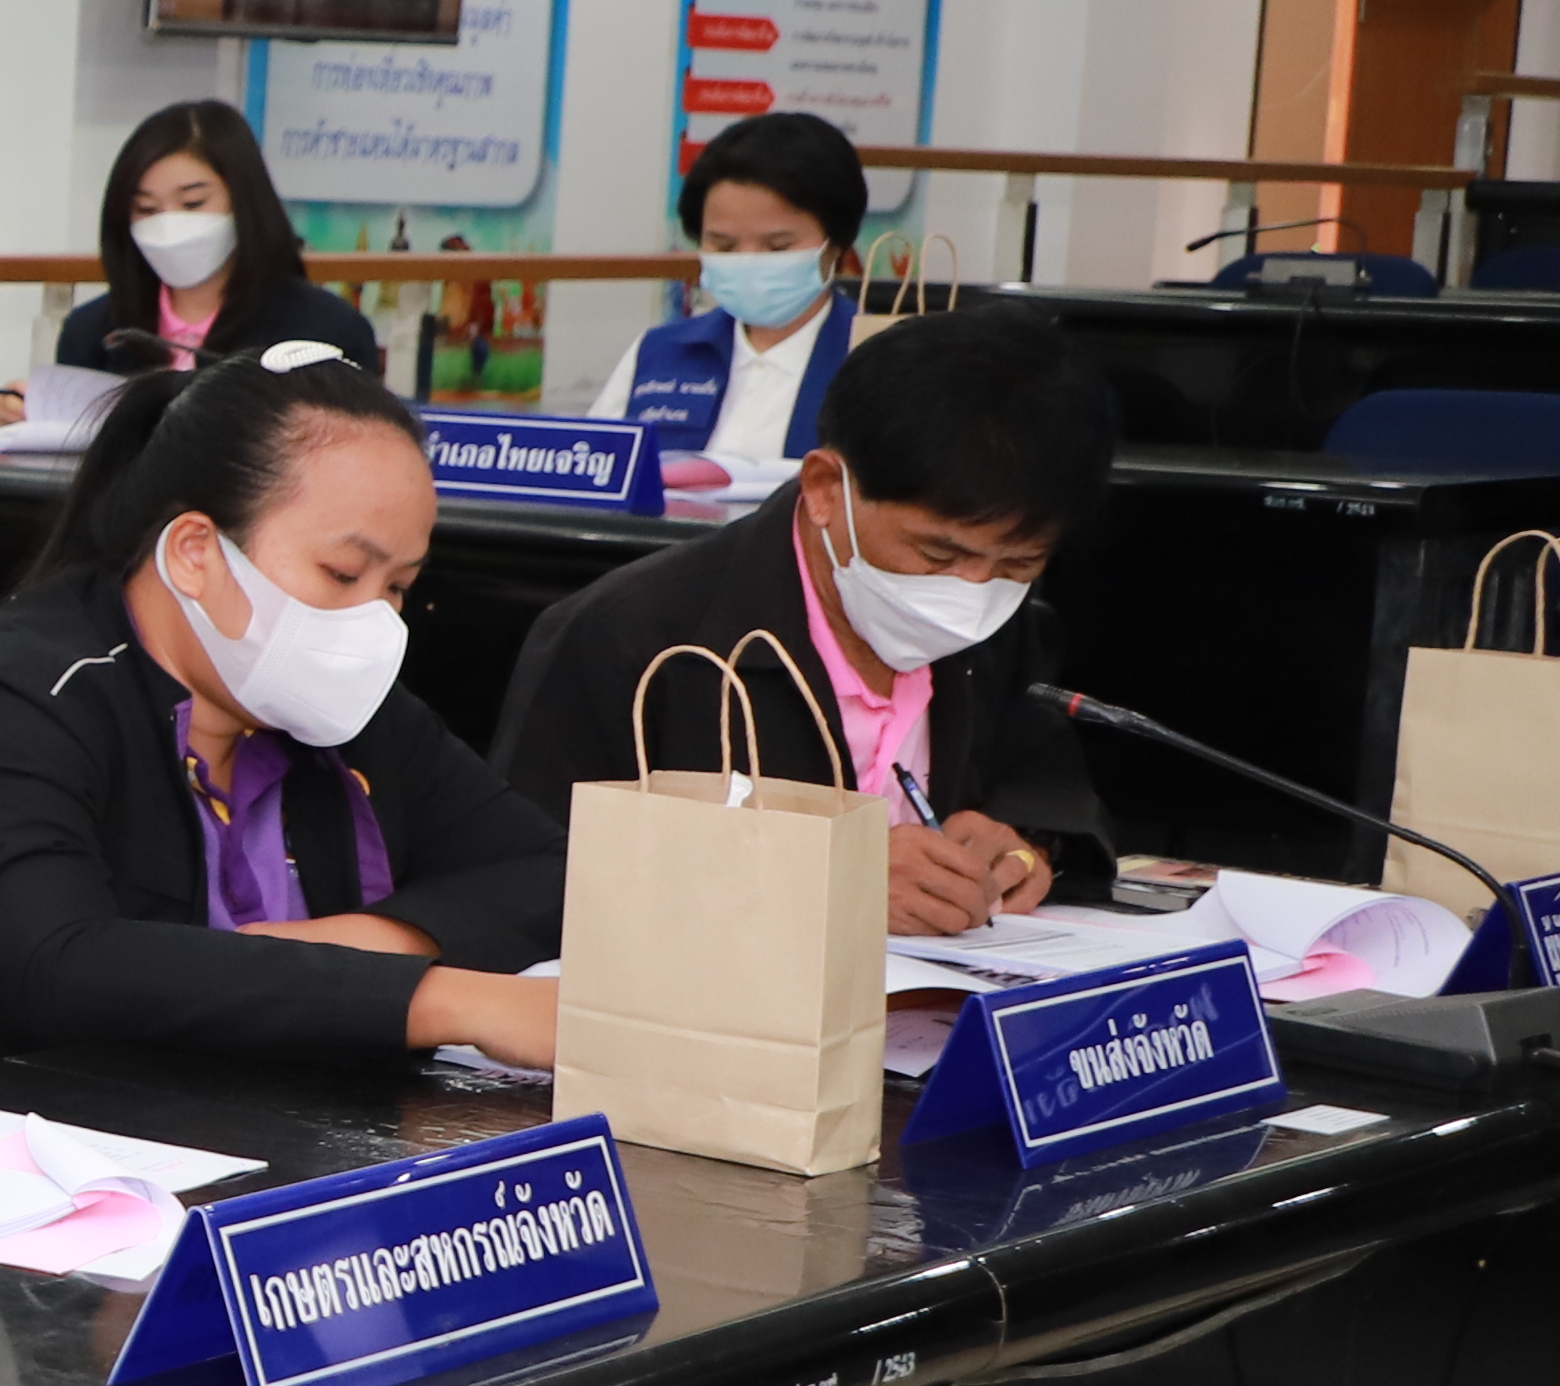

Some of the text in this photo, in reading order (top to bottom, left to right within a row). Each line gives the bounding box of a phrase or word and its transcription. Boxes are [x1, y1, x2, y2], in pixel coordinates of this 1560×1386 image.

[1069, 1004, 1214, 1089] ขนส่งจังหวัด
[249, 1171, 615, 1331] เกษตรและสหกรณ์จังหวัด
